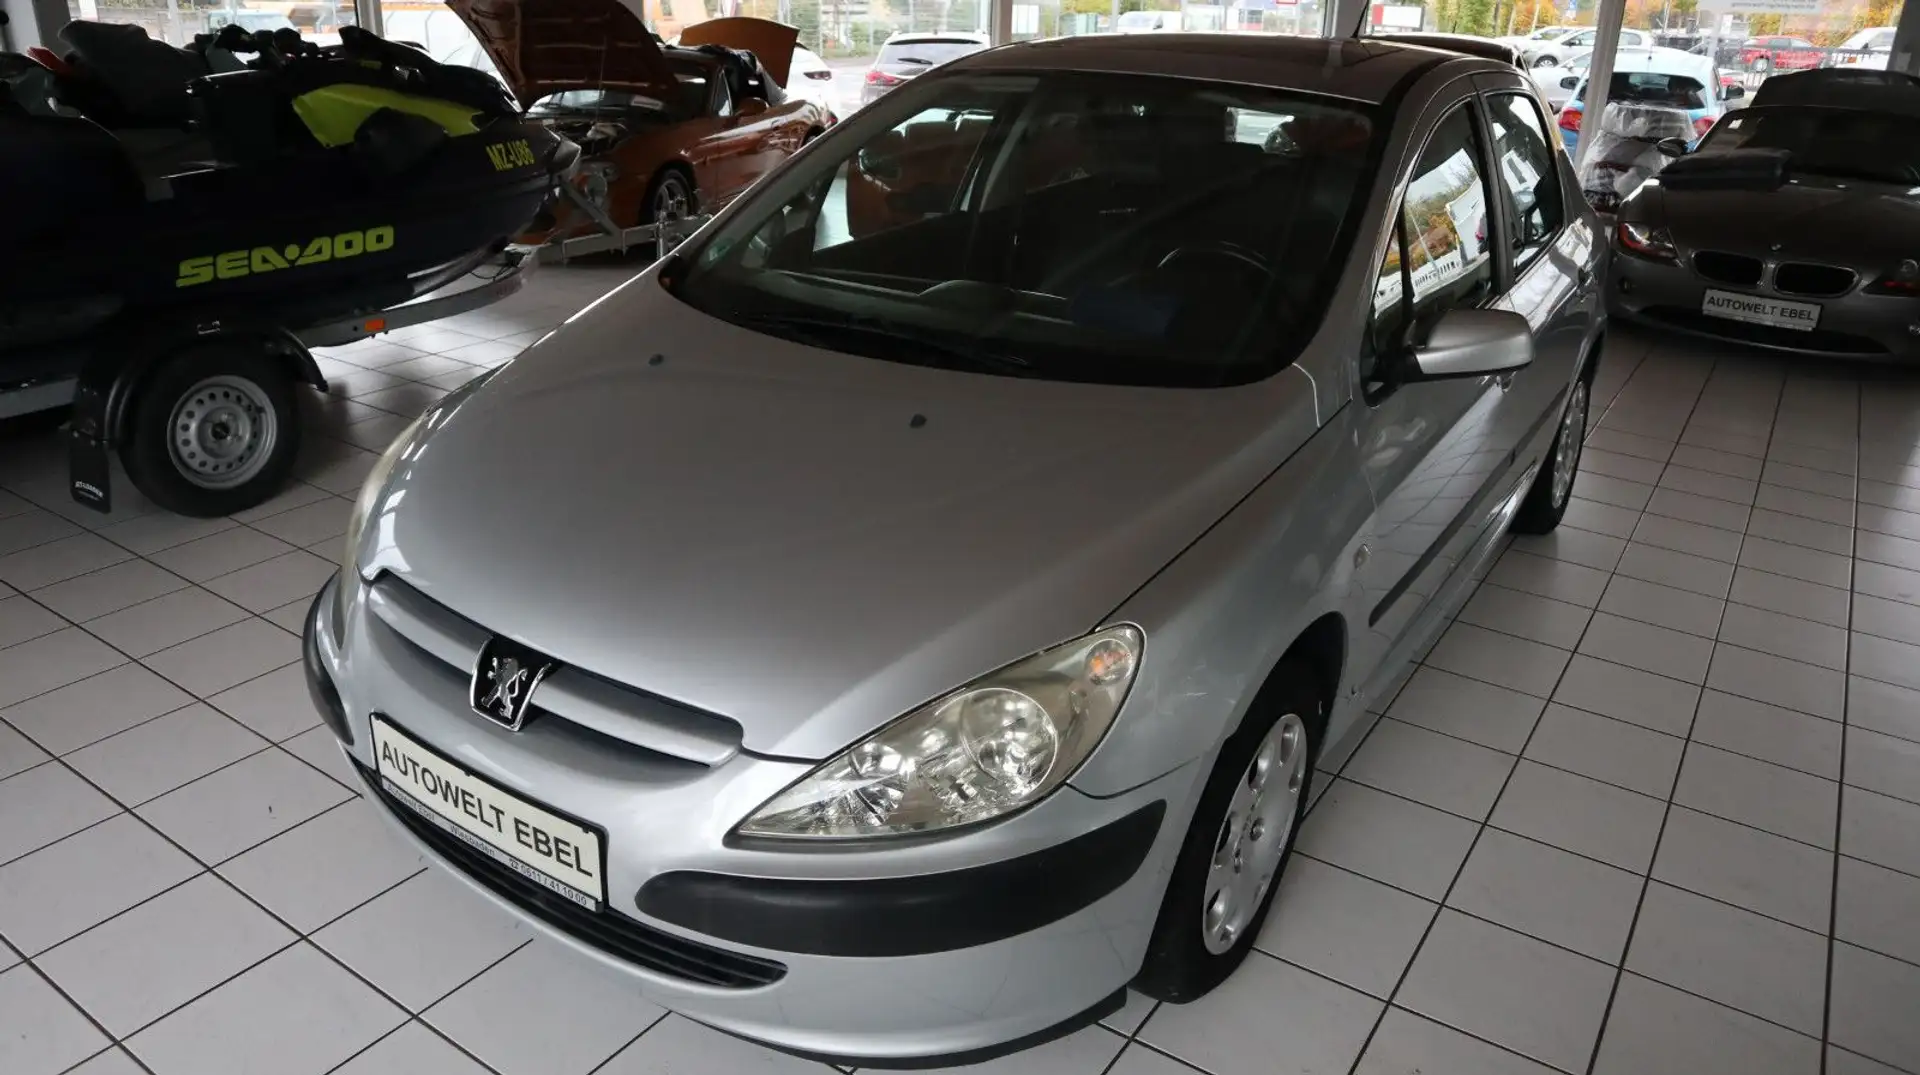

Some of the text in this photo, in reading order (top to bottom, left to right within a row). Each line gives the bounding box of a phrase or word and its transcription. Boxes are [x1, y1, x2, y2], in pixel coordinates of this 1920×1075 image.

[485, 138, 535, 171] MZ-U86
[1707, 296, 1814, 321] AUTOWELT EBEL
[382, 740, 593, 878] AUTOWELT EBEL
[450, 825, 495, 857] Wiesbaden
